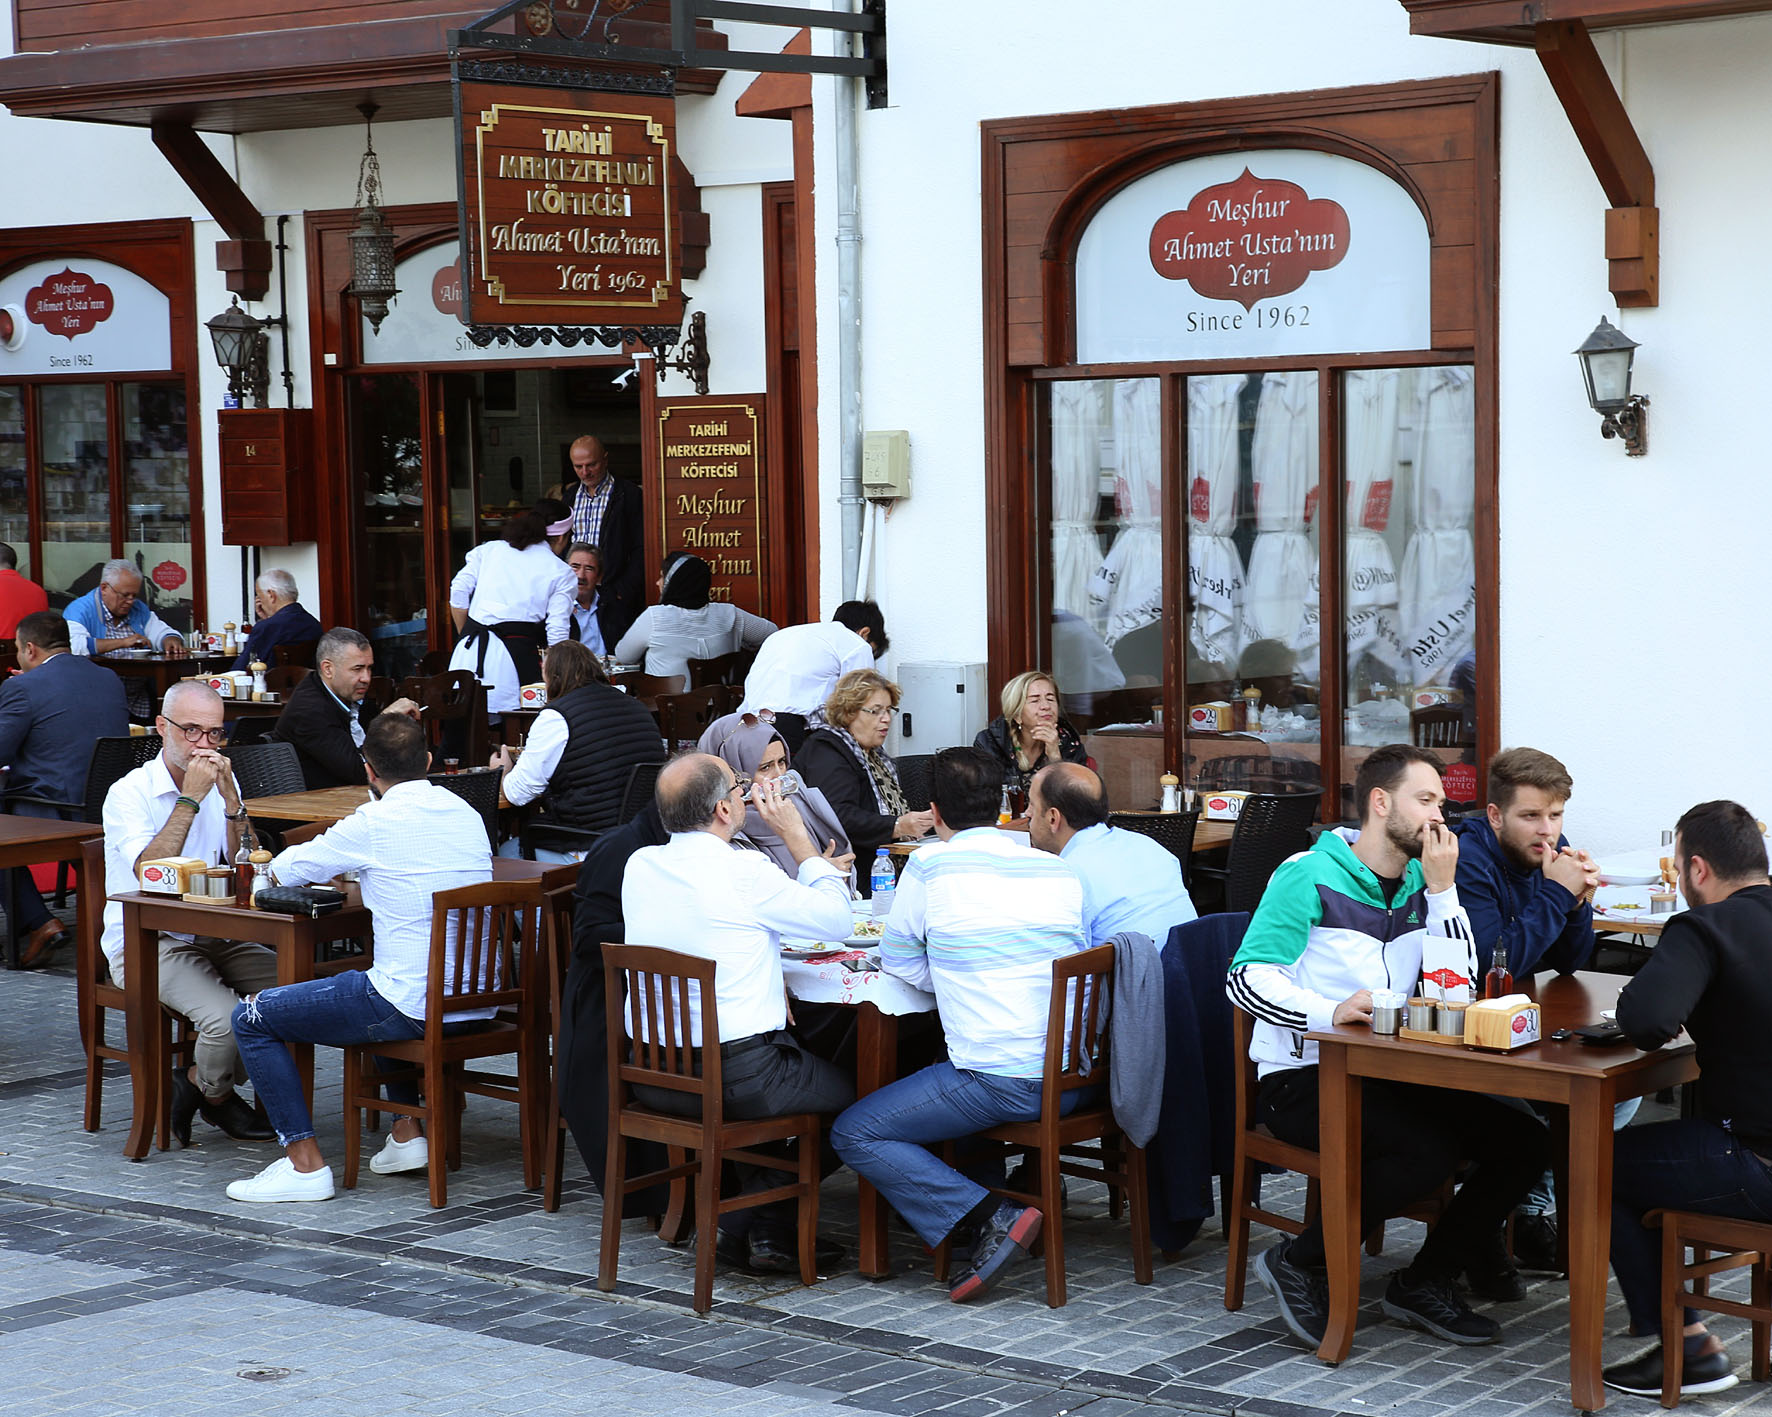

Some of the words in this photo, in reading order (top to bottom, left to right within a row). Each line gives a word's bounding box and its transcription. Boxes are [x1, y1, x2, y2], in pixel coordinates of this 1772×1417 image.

[542, 124, 612, 155] TARİHİ
[499, 155, 655, 185] MERKEZEFENDİ
[527, 183, 631, 216] KÖFTECİSİ
[1207, 190, 1291, 227] Meşhur
[491, 218, 564, 252] Ahmet
[568, 228, 661, 256] Usta'nın
[1164, 232, 1235, 262] Ahmet
[1240, 229, 1336, 257] Usta'nın
[556, 264, 601, 291] Yeri
[608, 271, 646, 293] 1962
[1228, 263, 1271, 287] Yeri
[52, 280, 87, 296] Meşhur
[34, 298, 64, 314] Ahmet
[61, 315, 81, 328] Yeri
[1187, 311, 1243, 332] Since
[1257, 305, 1310, 329] 1962
[50, 356, 71, 367] Since
[74, 354, 94, 366] 1962
[689, 420, 728, 437] TARİHİ
[245, 445, 256, 457] 14
[666, 440, 752, 458] MERKEZEFENDİ
[681, 461, 739, 478] KÖFTECİSİ
[677, 488, 746, 520] Meşhur
[682, 521, 742, 548] Ahmet
[709, 582, 731, 601] eri
[162, 866, 176, 886] 33
[1527, 1009, 1538, 1033] 30
